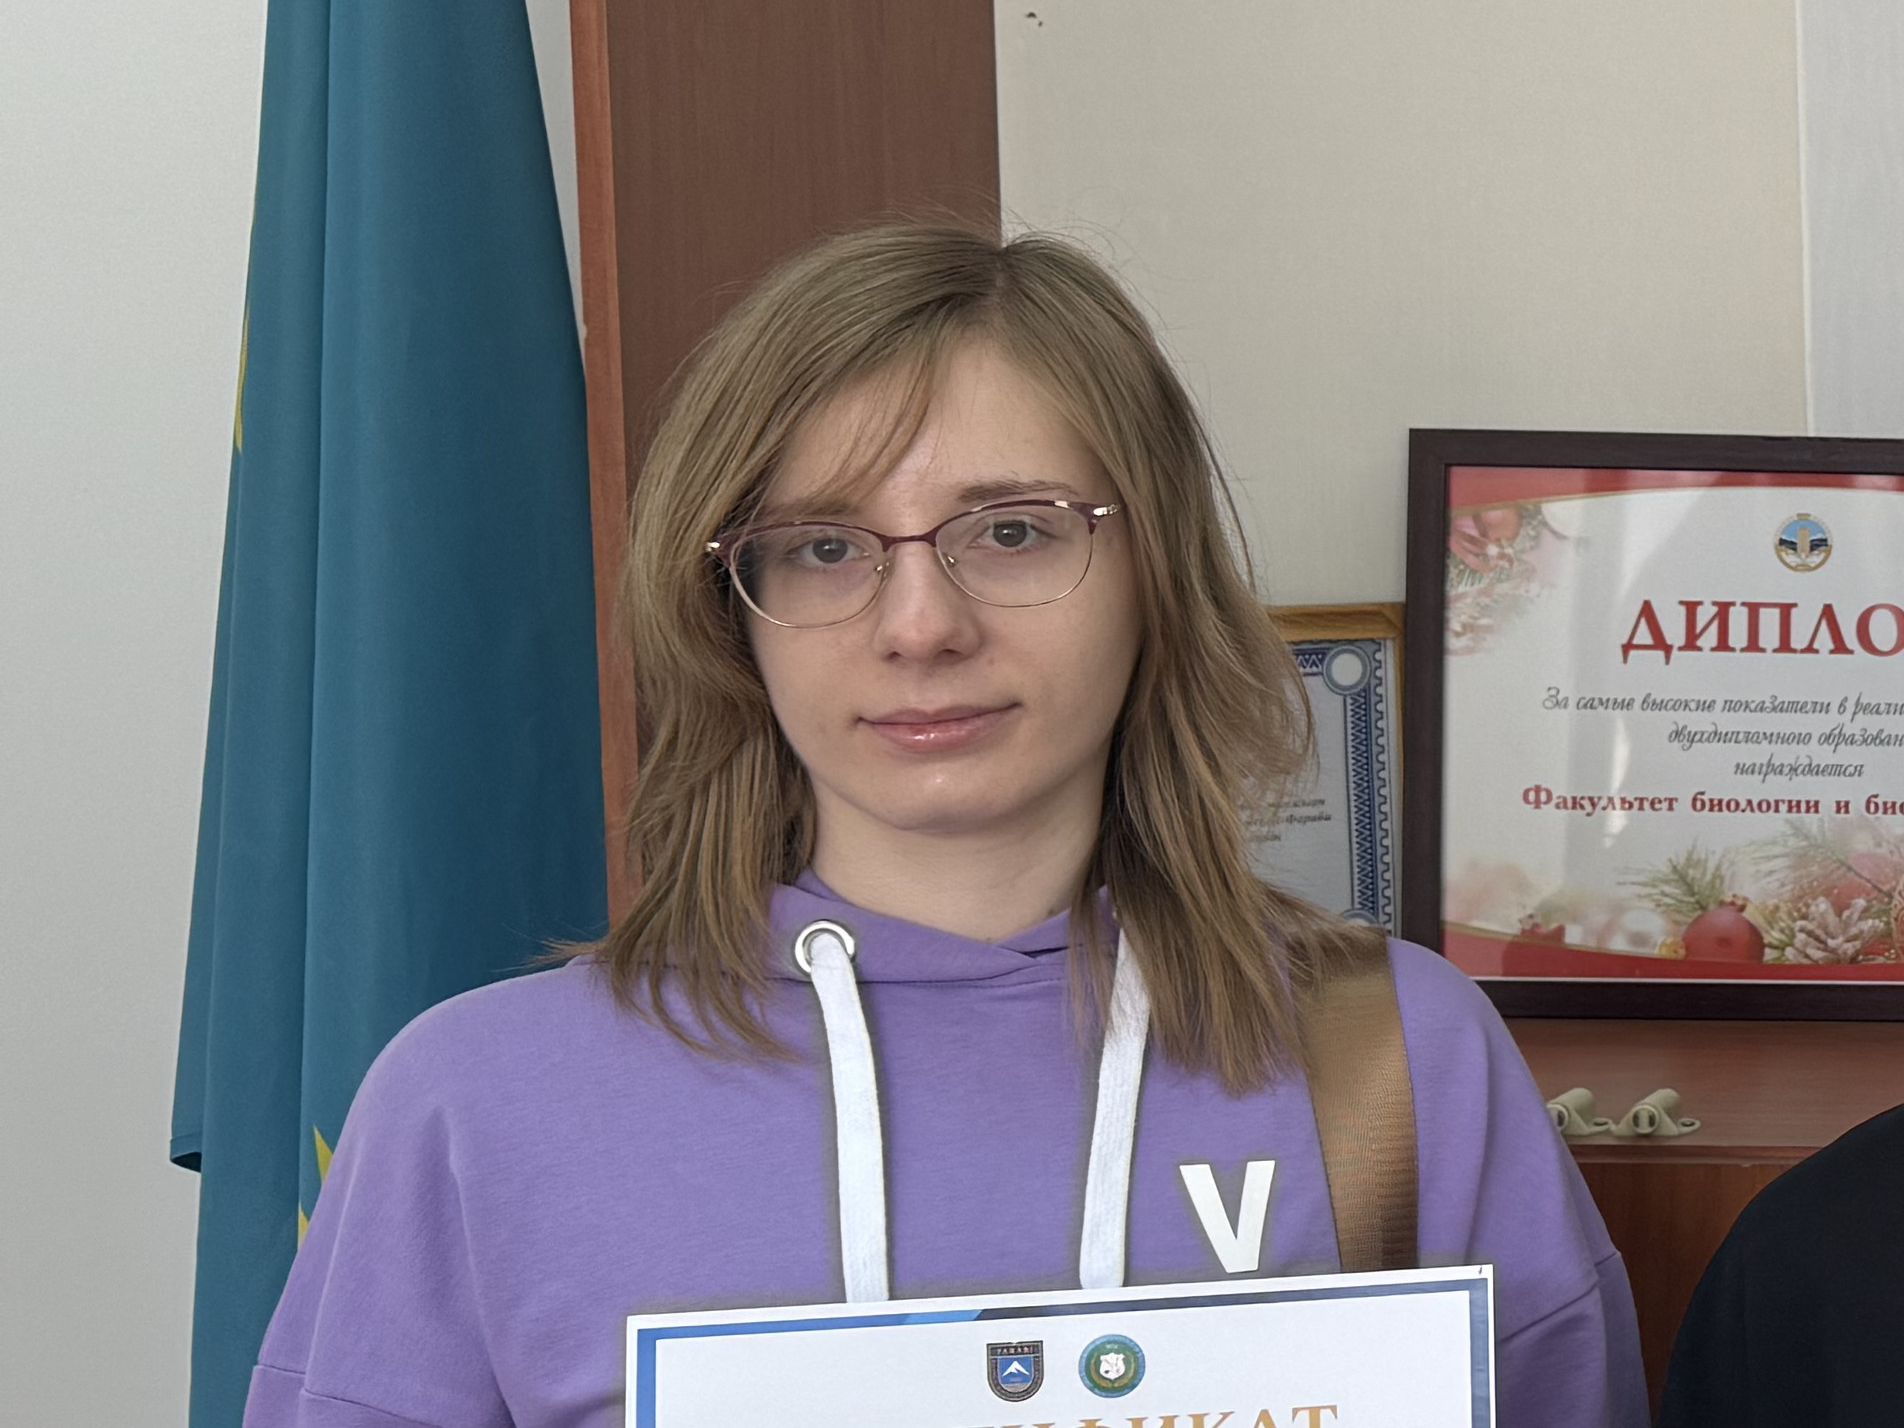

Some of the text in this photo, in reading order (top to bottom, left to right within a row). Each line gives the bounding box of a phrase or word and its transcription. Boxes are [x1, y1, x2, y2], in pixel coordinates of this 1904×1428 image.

[1542, 687, 1570, 711] За
[1576, 695, 1635, 713] самые
[1640, 693, 1716, 714] высокие
[1721, 694, 1831, 716] показатели
[1733, 753, 1864, 784] награждается
[1522, 784, 1679, 818] Факультет
[1691, 791, 1821, 816] биологии
[1834, 799, 1851, 815] и
